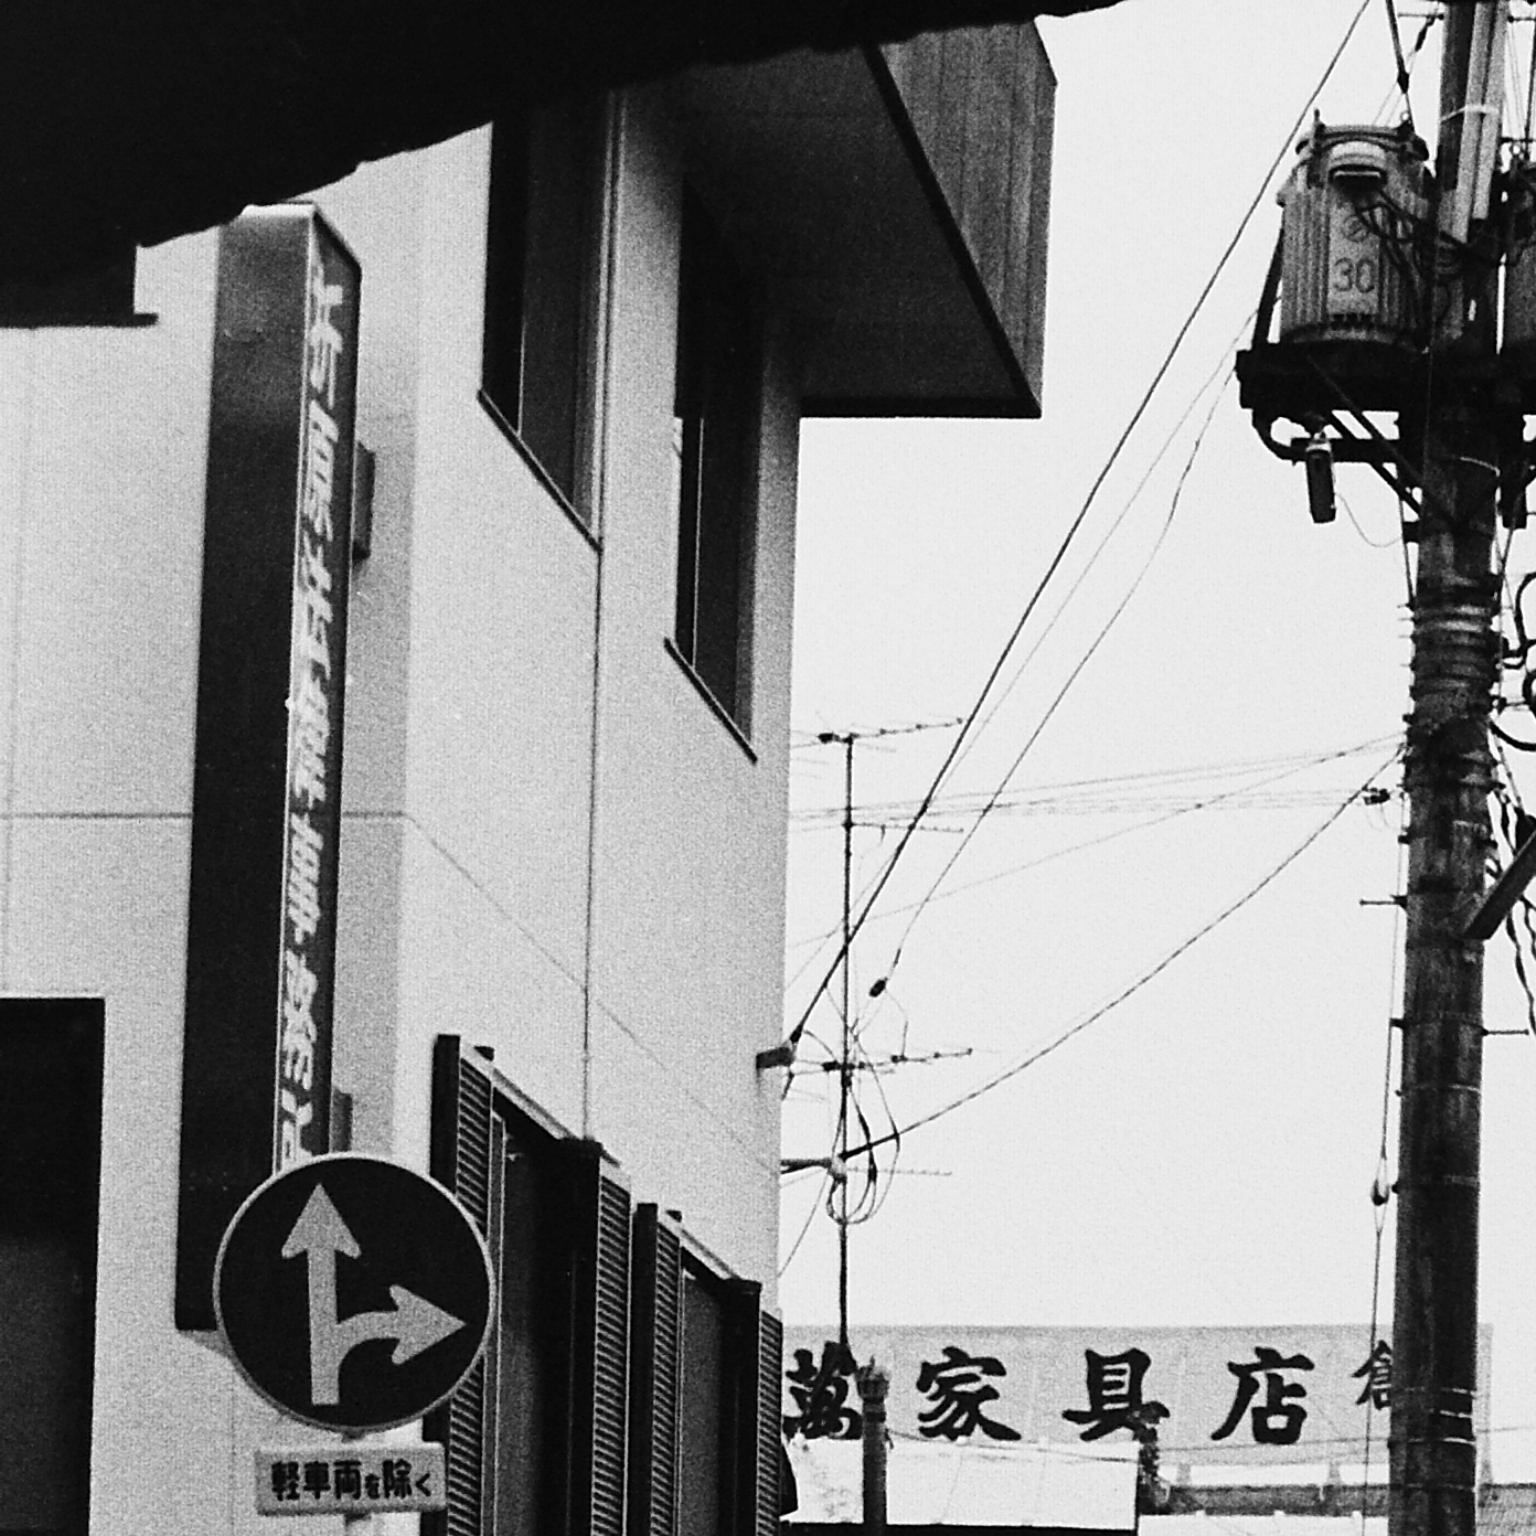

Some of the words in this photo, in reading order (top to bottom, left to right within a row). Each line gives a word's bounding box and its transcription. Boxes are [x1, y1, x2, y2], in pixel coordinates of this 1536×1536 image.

[1333, 257, 1376, 294] 30
[271, 1458, 432, 1502] 軽車両を除く
